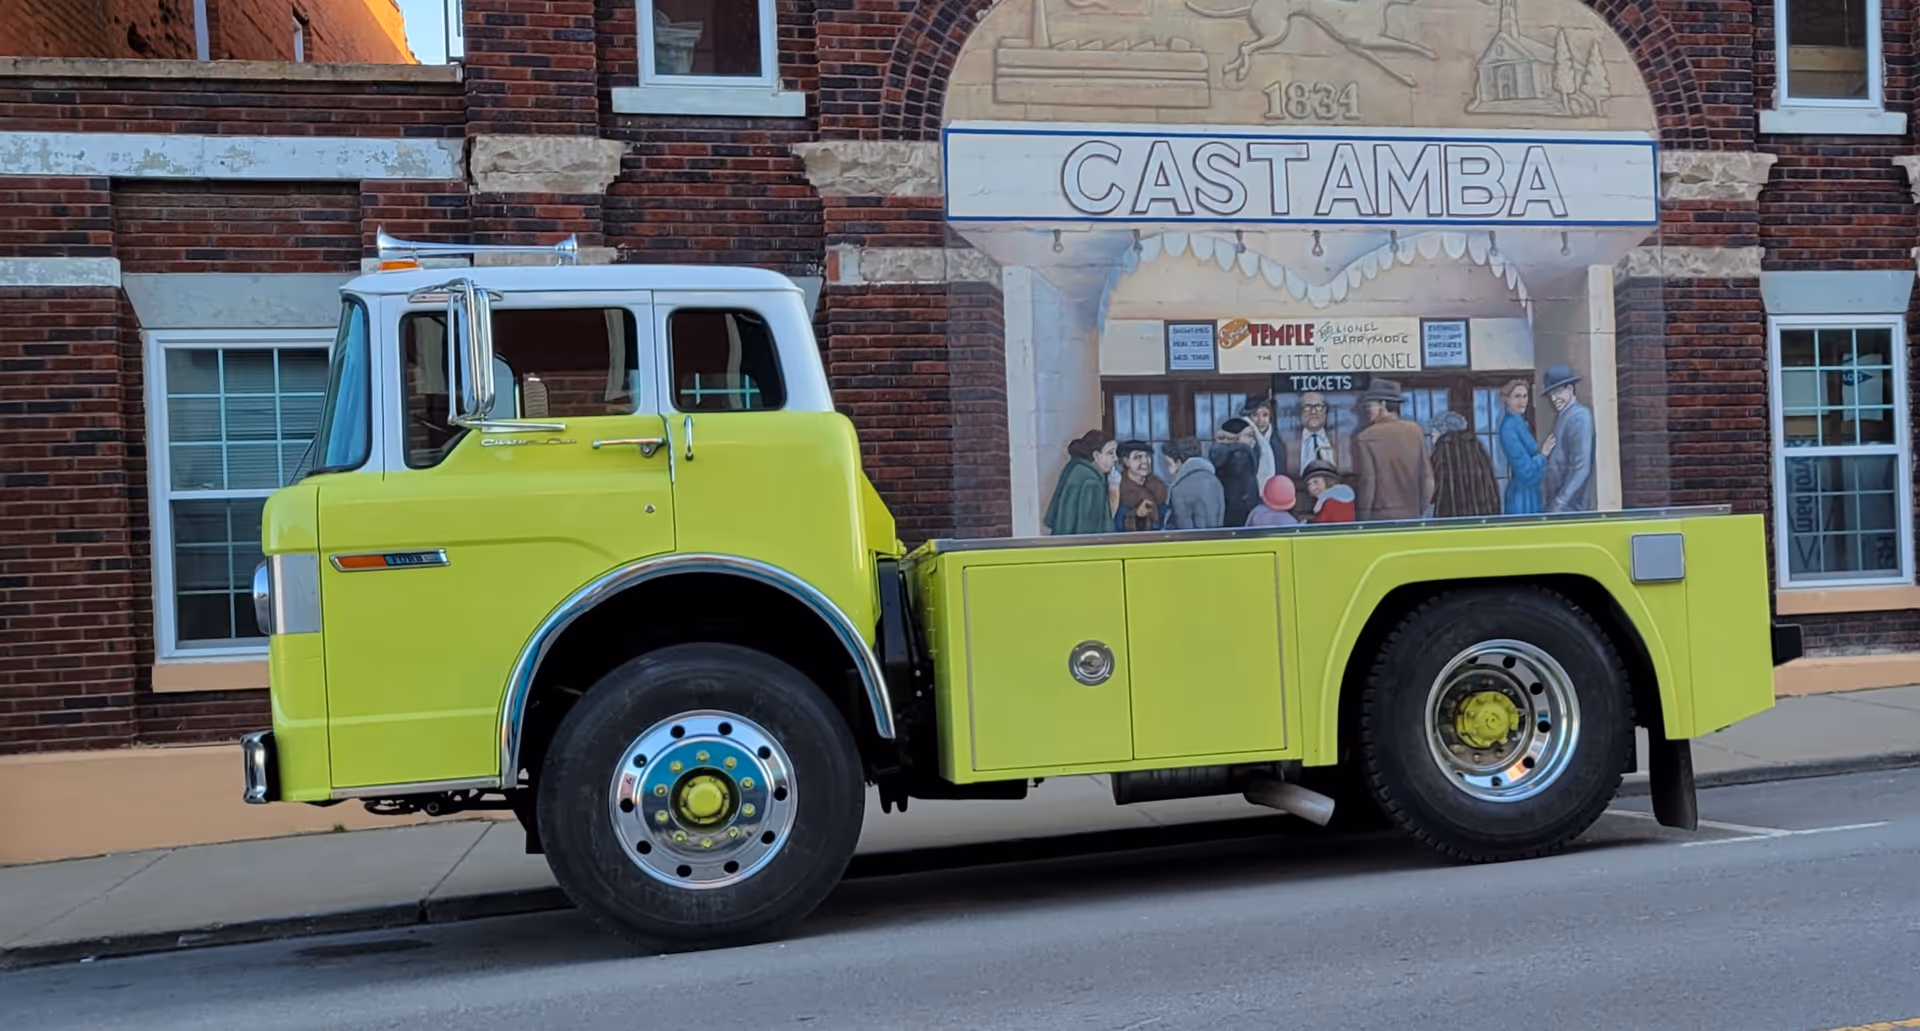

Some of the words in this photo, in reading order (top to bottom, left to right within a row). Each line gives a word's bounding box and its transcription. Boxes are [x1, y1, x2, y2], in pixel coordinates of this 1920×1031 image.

[1264, 81, 1362, 119] 1834
[1061, 140, 1569, 217] CASTAMBA
[1248, 323, 1315, 346] TEMPLE
[1336, 322, 1379, 334] LIONEL
[1332, 333, 1409, 345] BARRYMORE
[1278, 354, 1329, 370] LITTLE
[1341, 352, 1417, 370] COLONEL
[1290, 375, 1352, 391] TICKETS
